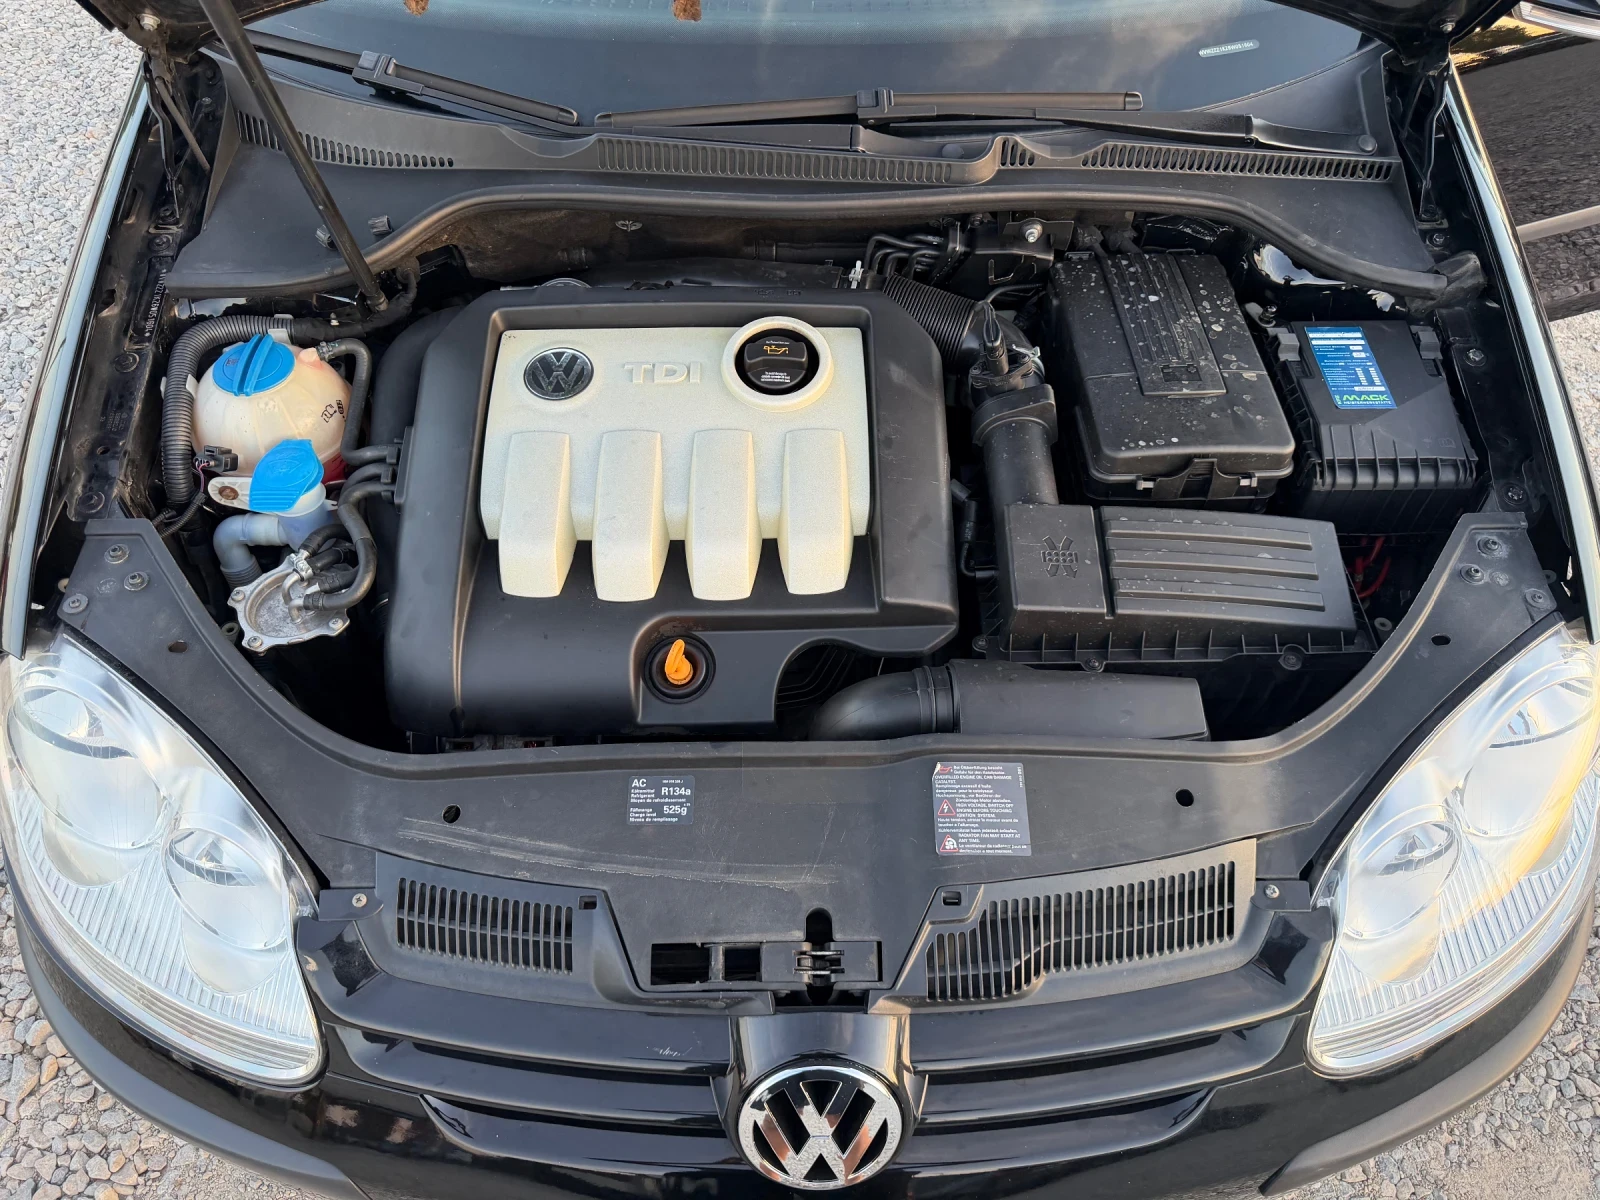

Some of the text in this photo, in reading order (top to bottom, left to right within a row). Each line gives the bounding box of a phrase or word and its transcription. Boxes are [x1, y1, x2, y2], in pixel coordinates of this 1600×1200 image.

[525, 348, 593, 400] VW
[624, 362, 702, 384] TDI
[632, 779, 646, 787] AC
[662, 787, 691, 795] R134a
[664, 806, 687, 815] 525g
[741, 1068, 900, 1188] VW
